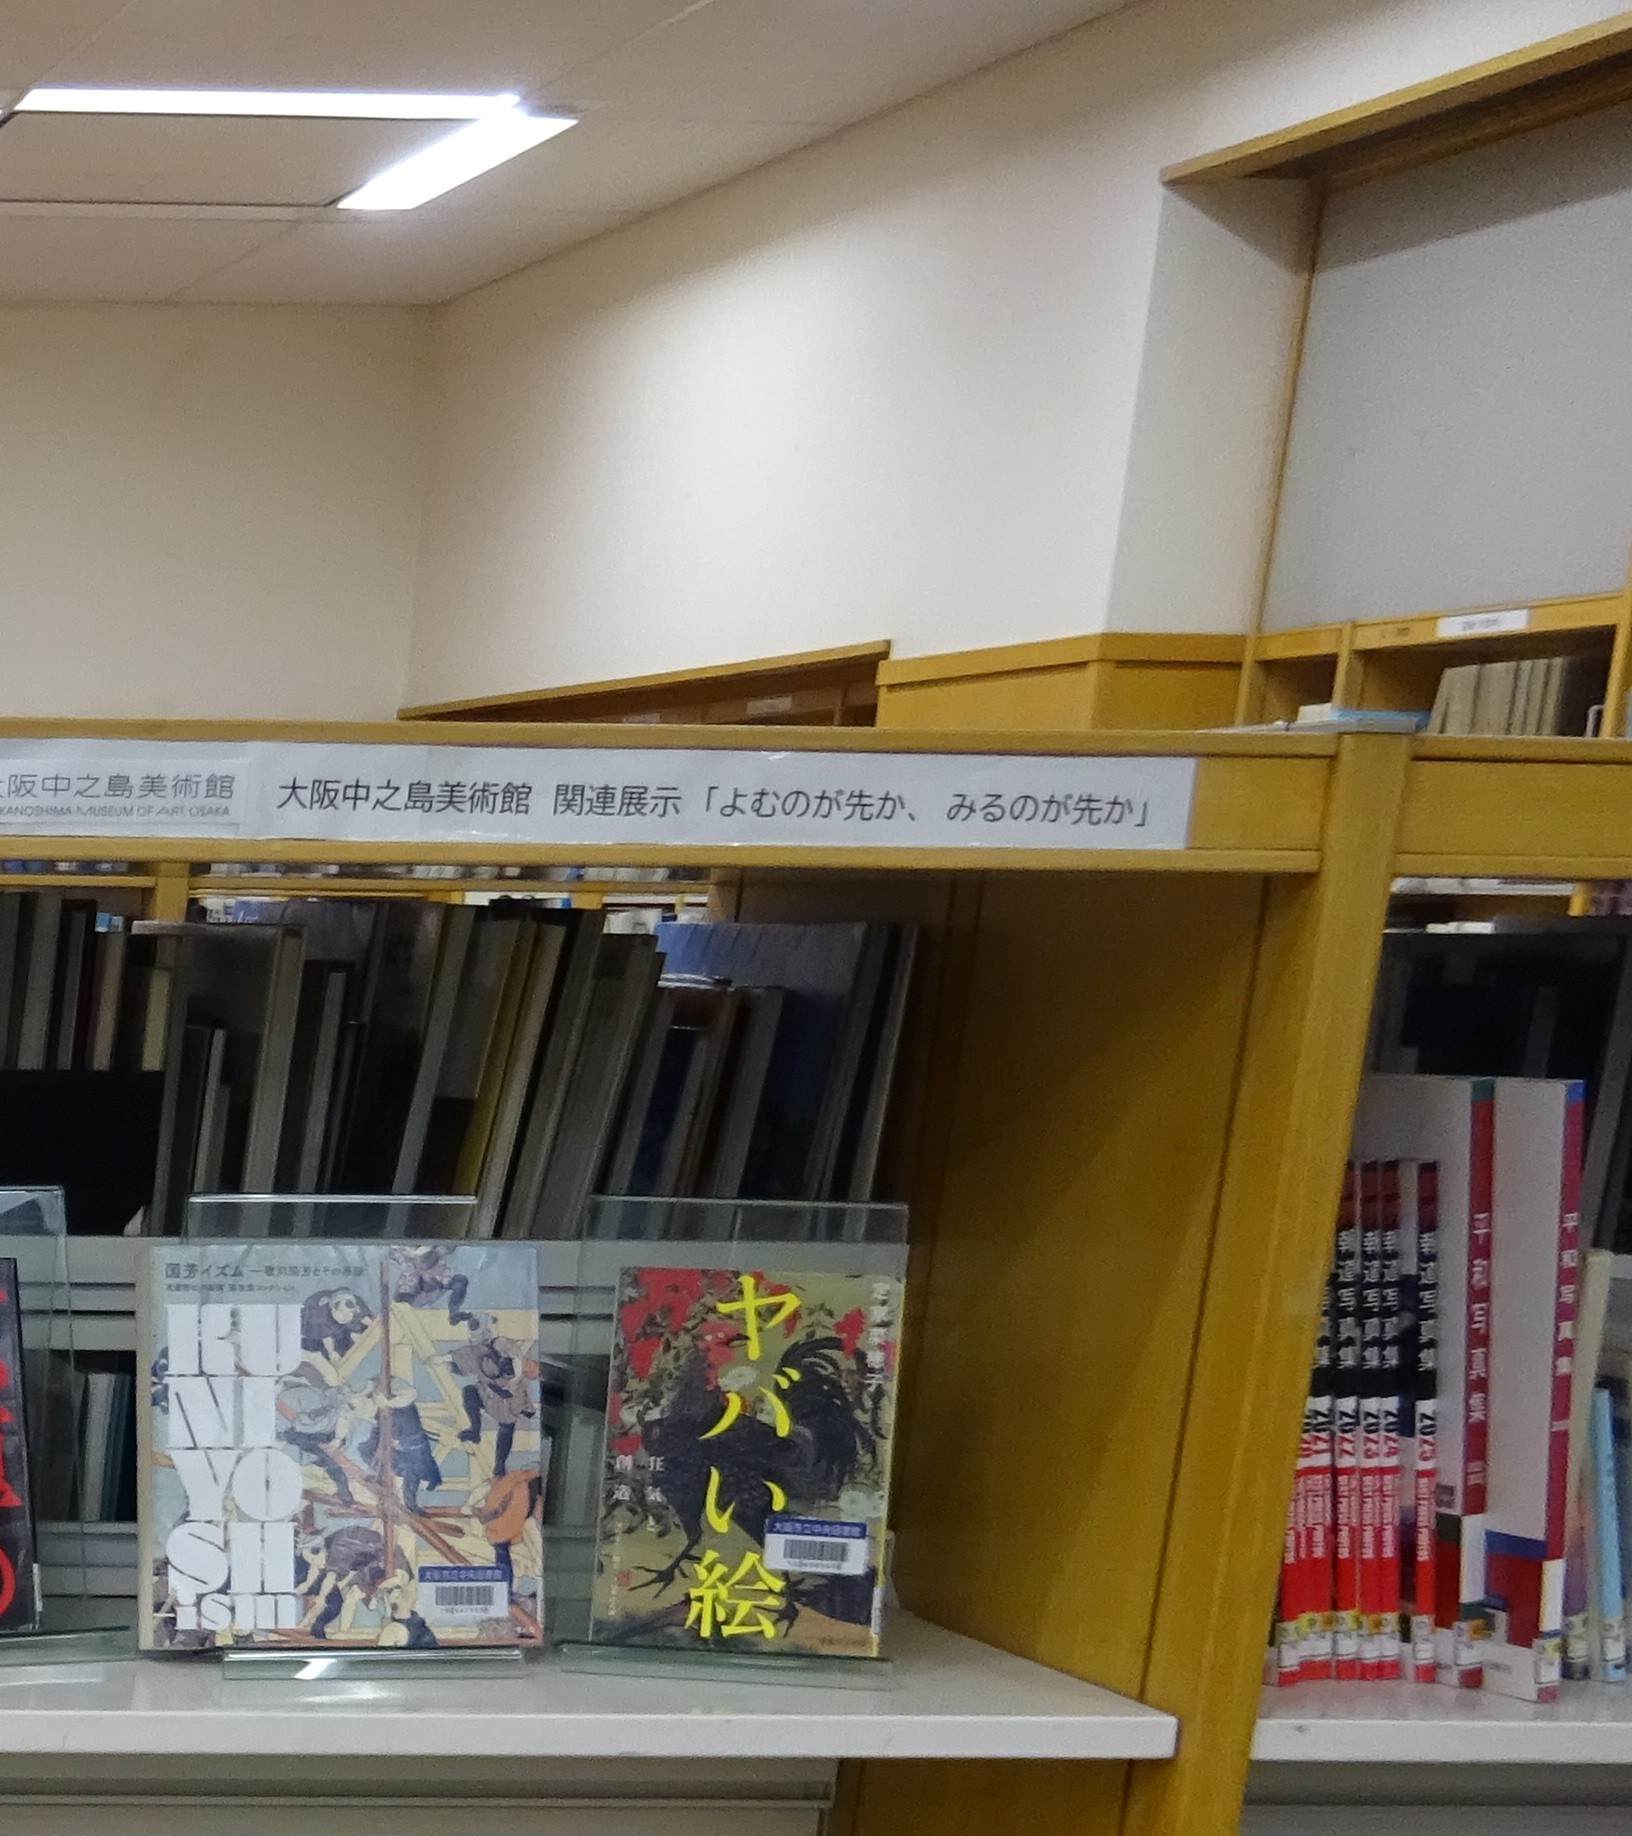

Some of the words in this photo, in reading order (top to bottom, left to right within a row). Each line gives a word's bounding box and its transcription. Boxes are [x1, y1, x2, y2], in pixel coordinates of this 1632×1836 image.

[75, 804, 136, 818] MUSEUM
[190, 804, 233, 819] OSAKA
[278, 776, 532, 816] 大阪中之島美術館
[683, 1273, 802, 1641] ヤバい絵
